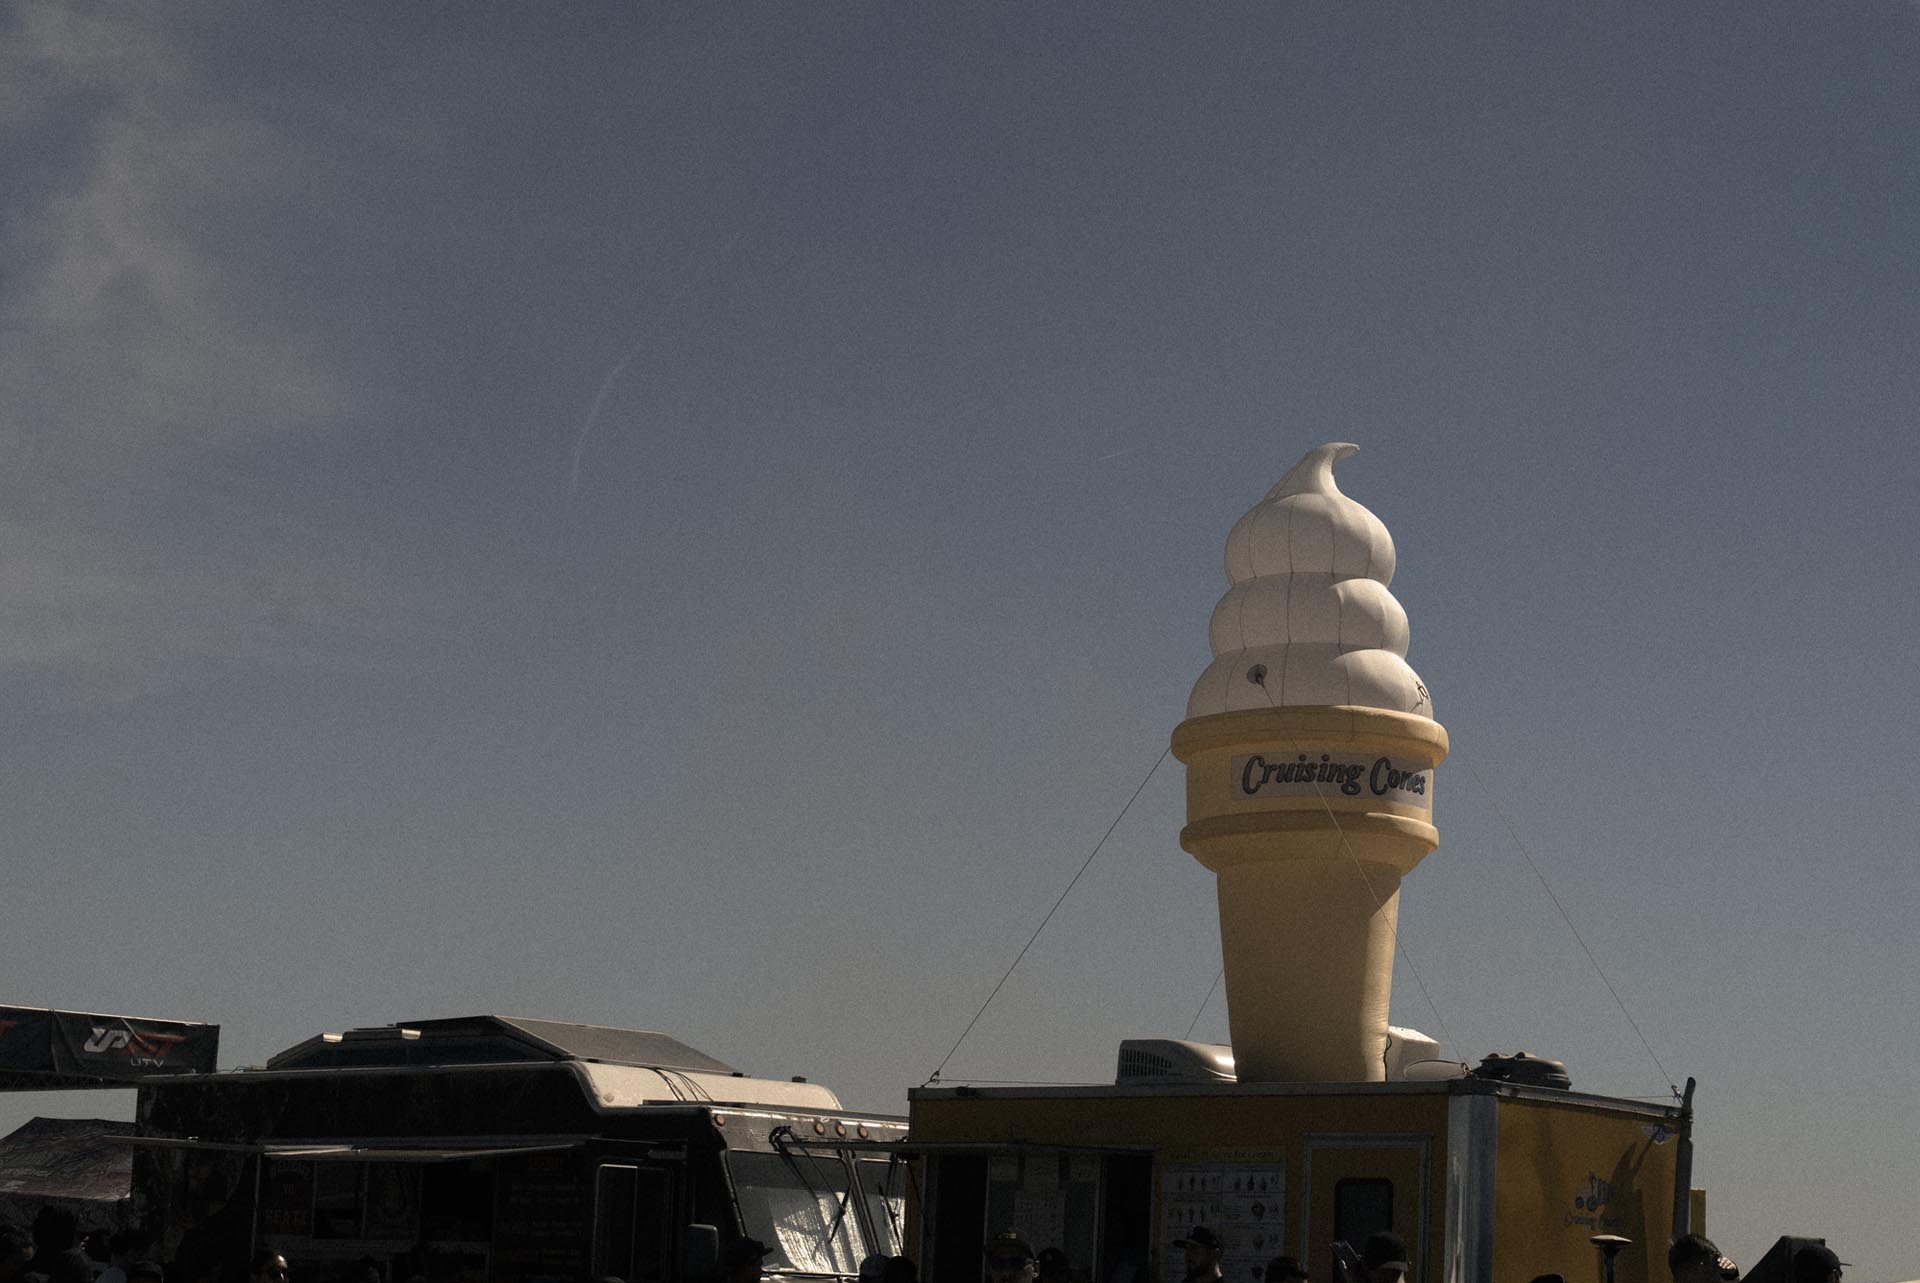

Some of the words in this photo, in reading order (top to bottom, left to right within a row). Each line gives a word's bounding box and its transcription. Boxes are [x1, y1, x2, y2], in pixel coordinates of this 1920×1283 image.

[1242, 754, 1365, 795] Cruising
[1370, 756, 1425, 795] Cones
[130, 1056, 165, 1069] UTV
